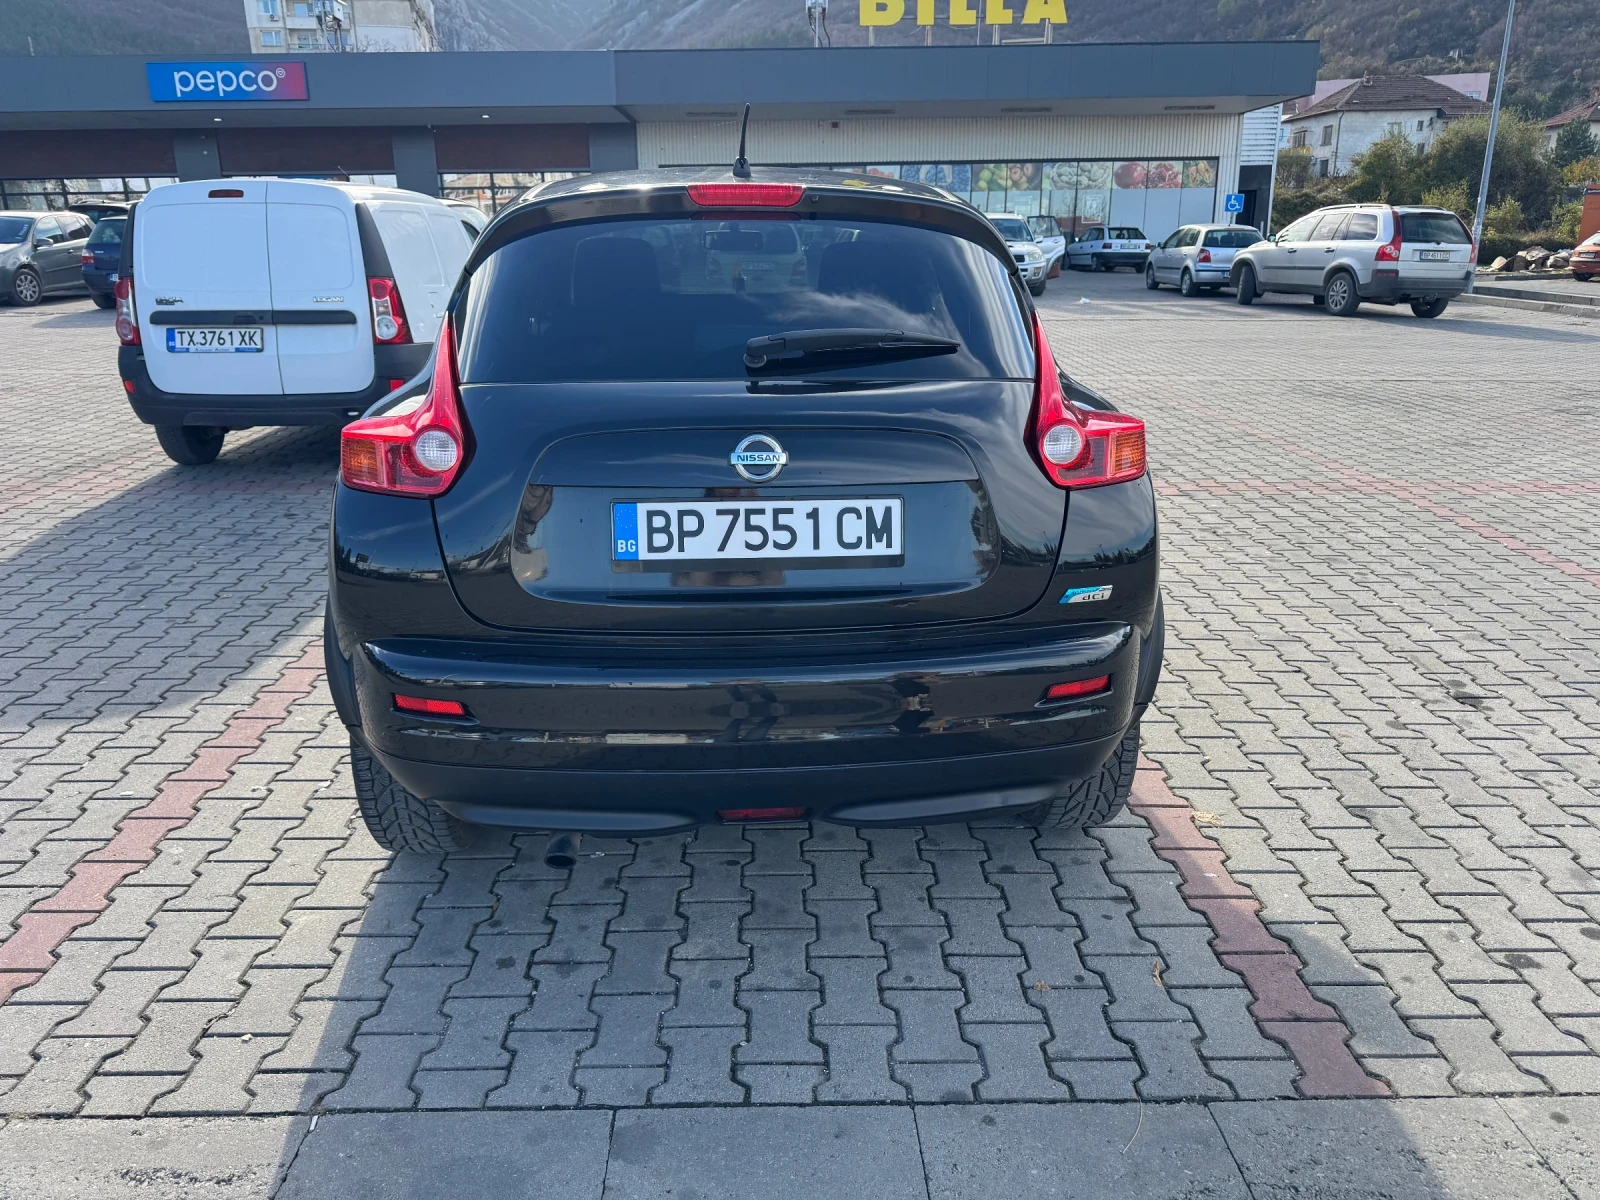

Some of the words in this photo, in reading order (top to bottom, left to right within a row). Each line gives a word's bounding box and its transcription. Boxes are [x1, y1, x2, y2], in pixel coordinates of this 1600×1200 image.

[173, 70, 278, 98] pepco
[177, 331, 196, 347] TX
[199, 331, 234, 346] 3761
[238, 331, 259, 346] XK
[736, 454, 780, 462] NISSAN
[646, 509, 705, 554] BP
[715, 507, 821, 552] 7551
[836, 506, 893, 550] CM
[617, 539, 636, 553] BG
